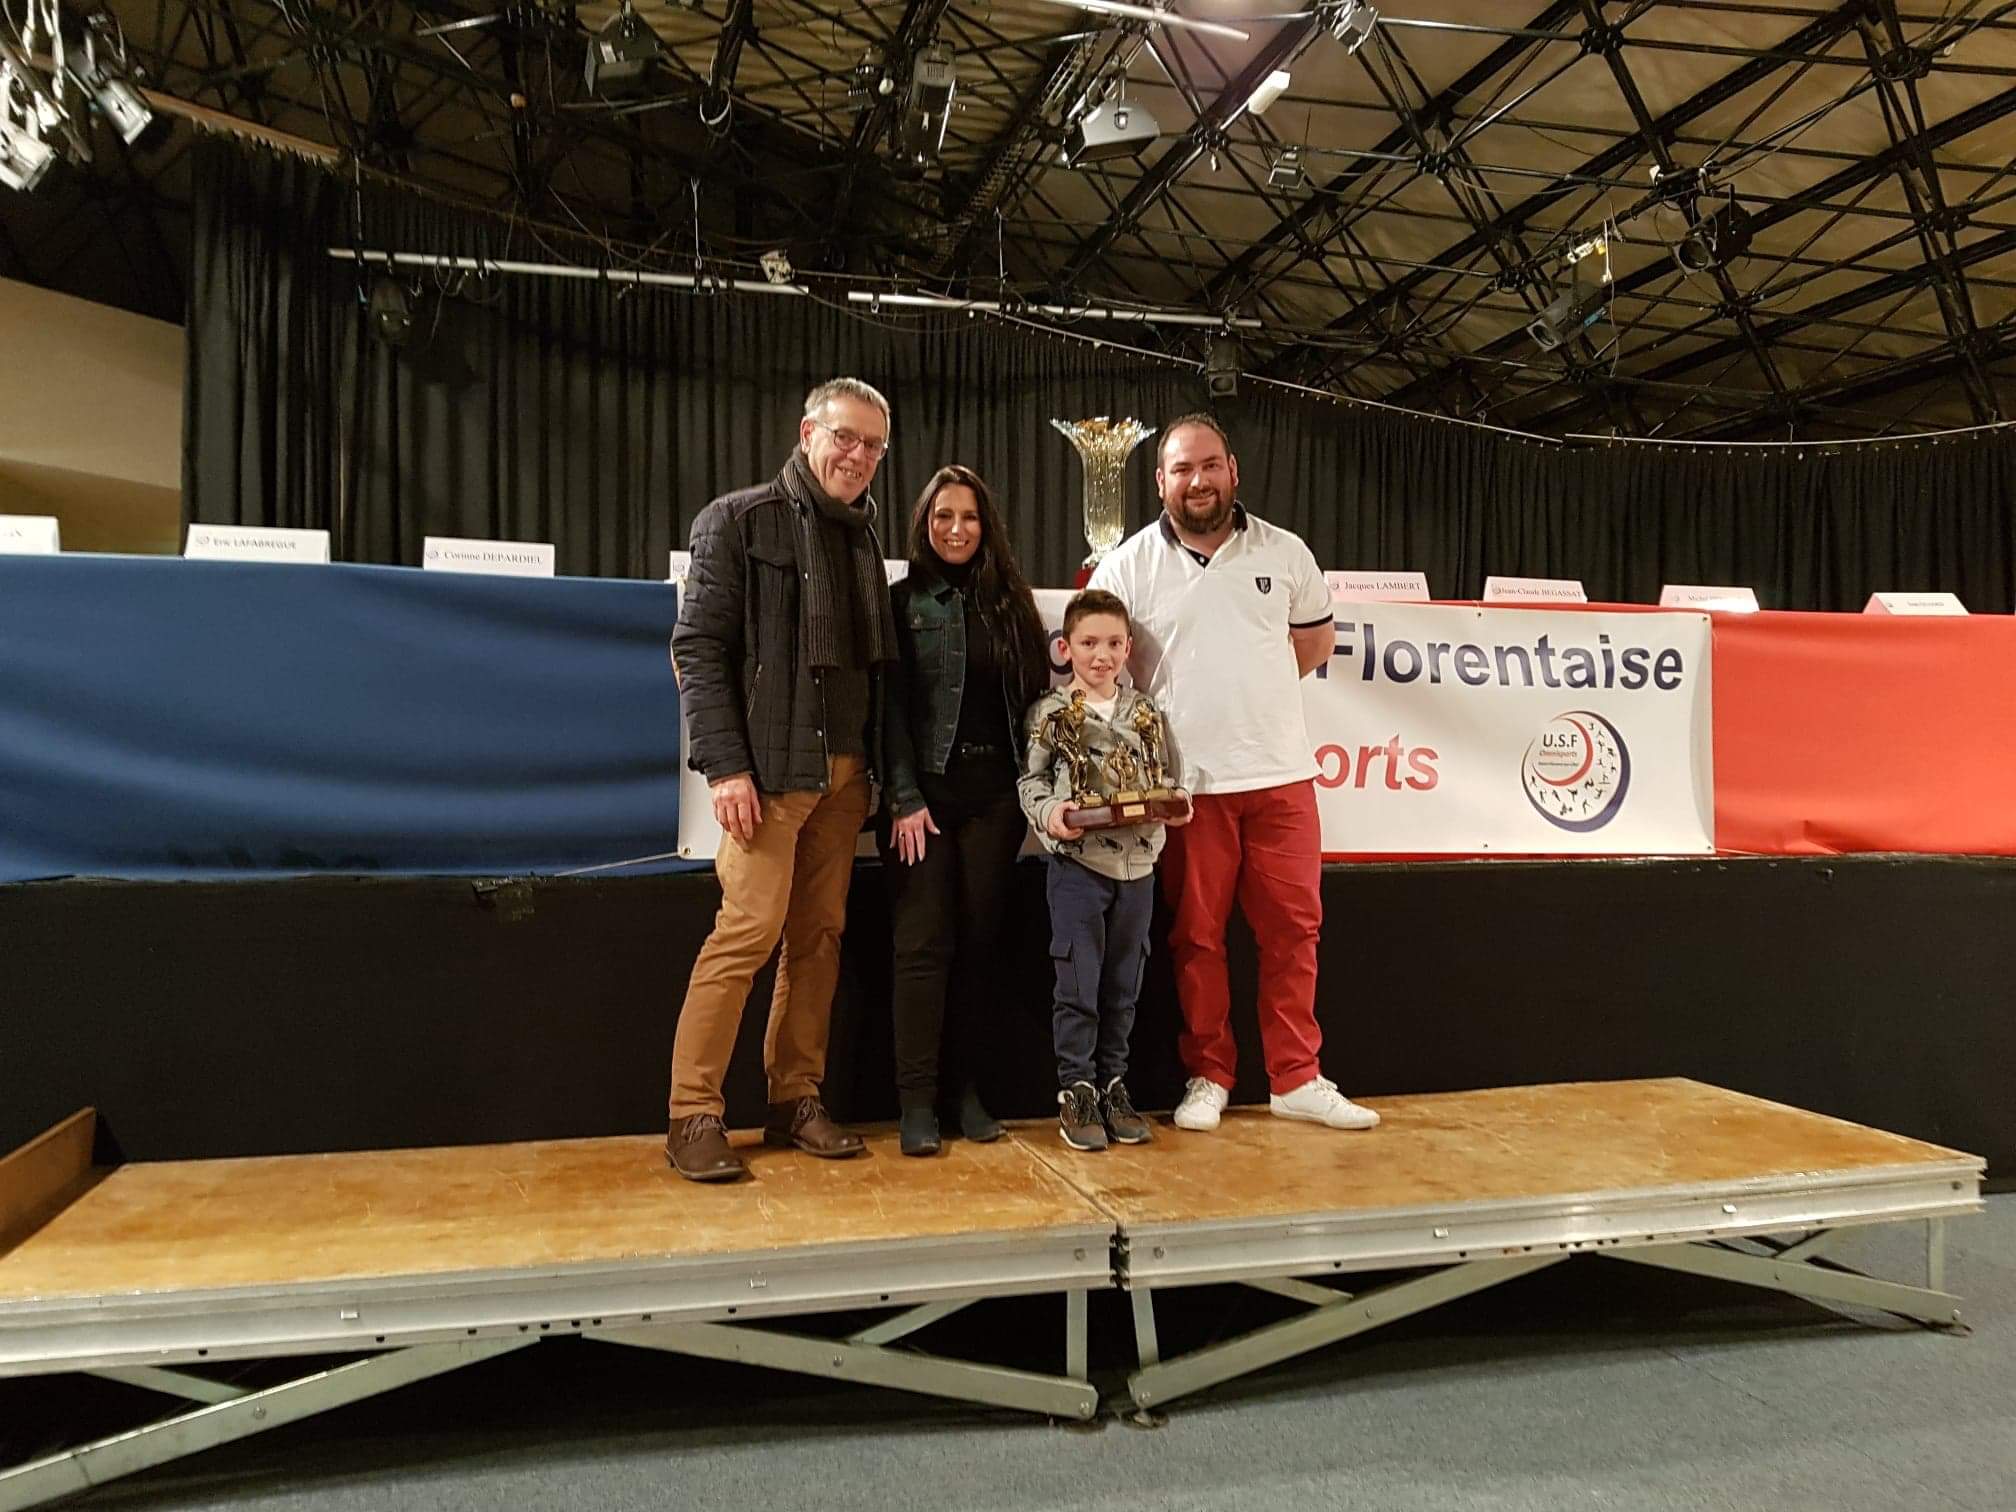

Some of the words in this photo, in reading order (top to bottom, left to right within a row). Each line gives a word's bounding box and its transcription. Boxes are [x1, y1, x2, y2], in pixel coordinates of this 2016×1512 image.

[1345, 582, 1374, 591] Jacques
[1377, 582, 1421, 590] LAMBERT
[1315, 621, 1683, 691] Florentaise
[1543, 734, 1578, 748] U.S.F
[1314, 734, 1439, 791] orts
